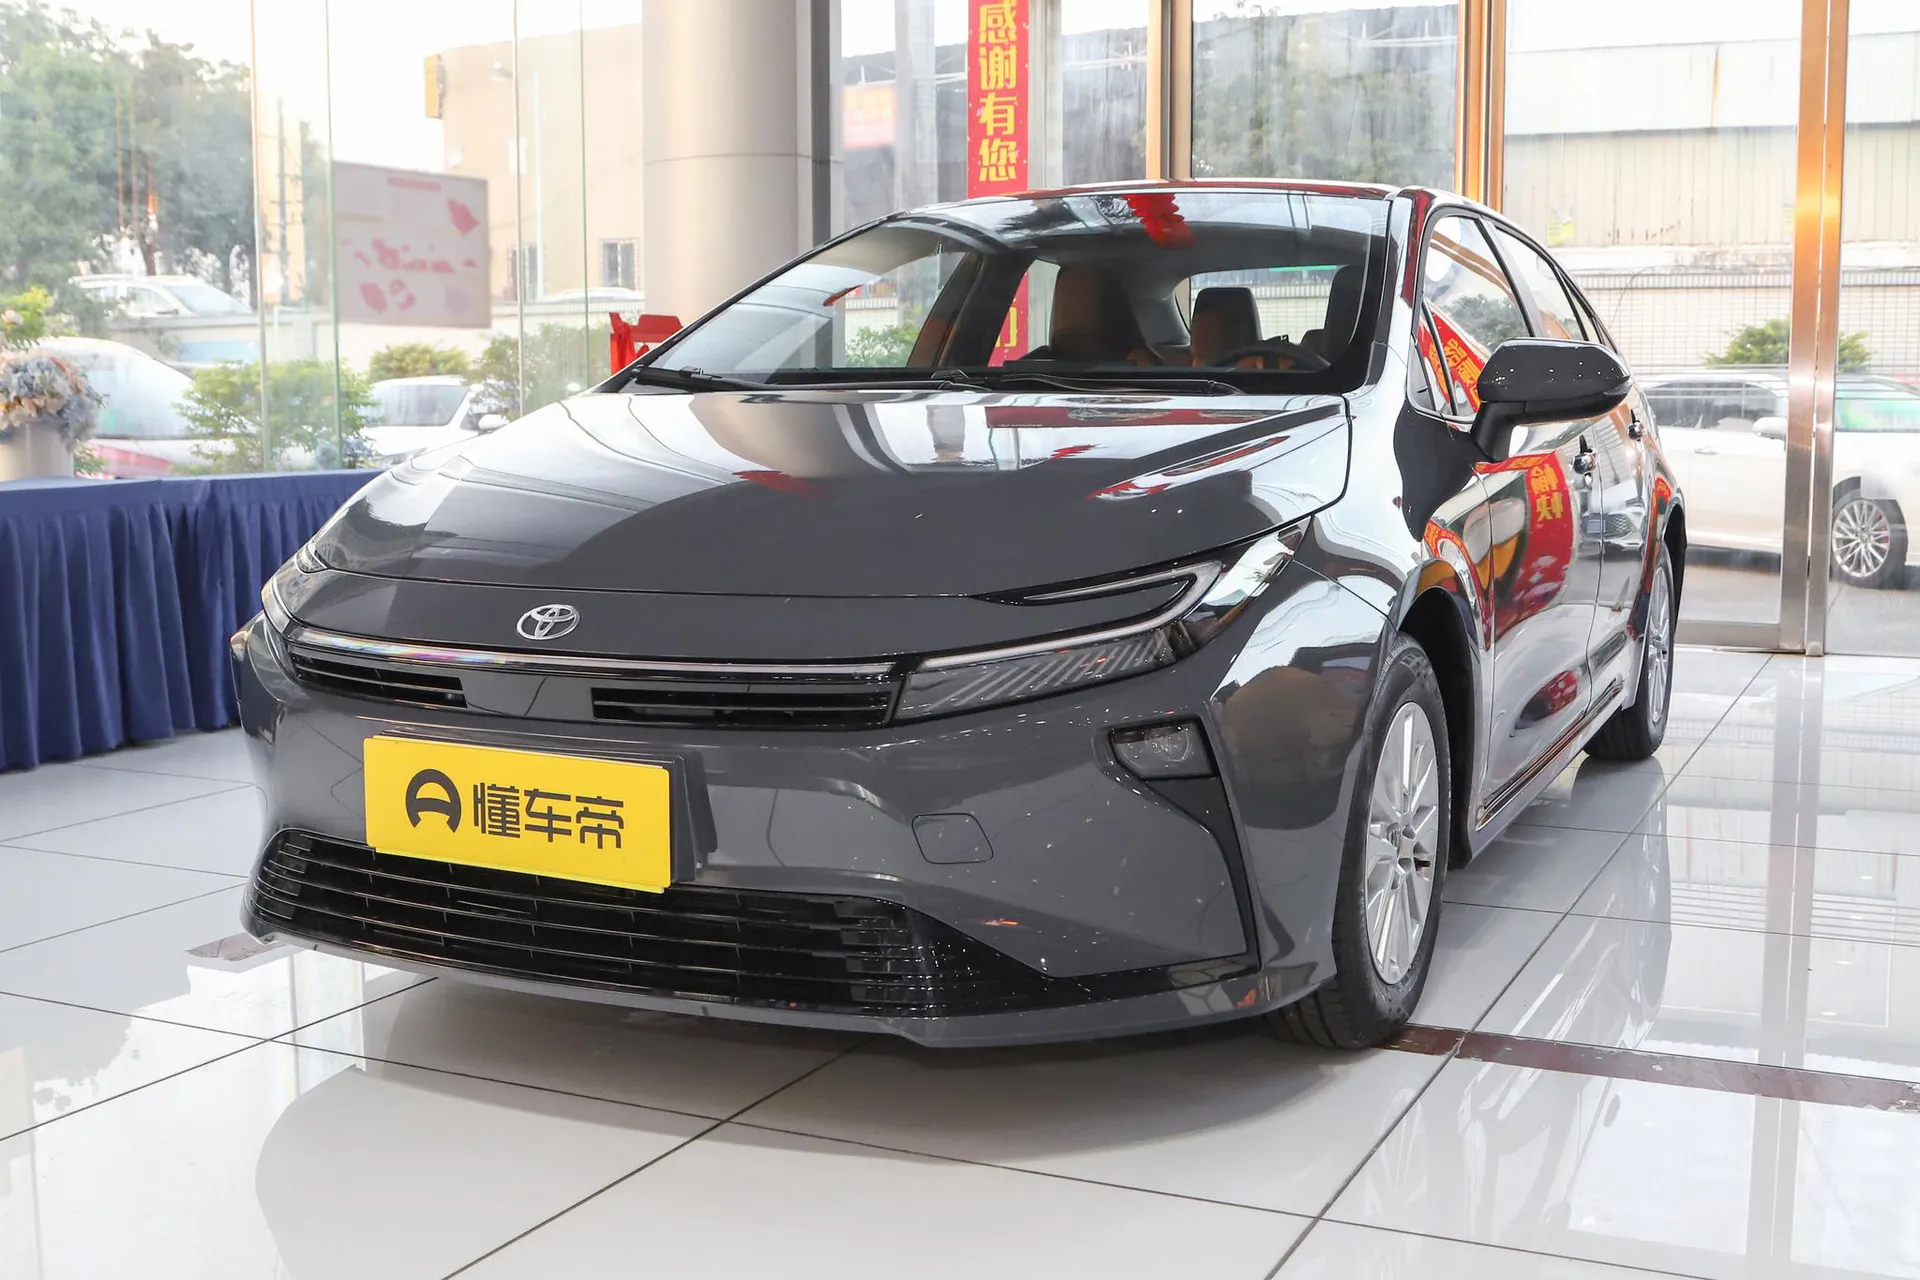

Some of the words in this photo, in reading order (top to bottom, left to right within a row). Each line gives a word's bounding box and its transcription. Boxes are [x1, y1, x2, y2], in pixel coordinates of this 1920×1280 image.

[979, 0, 1018, 182] 感谢有您
[473, 782, 624, 850] 懂车帝
